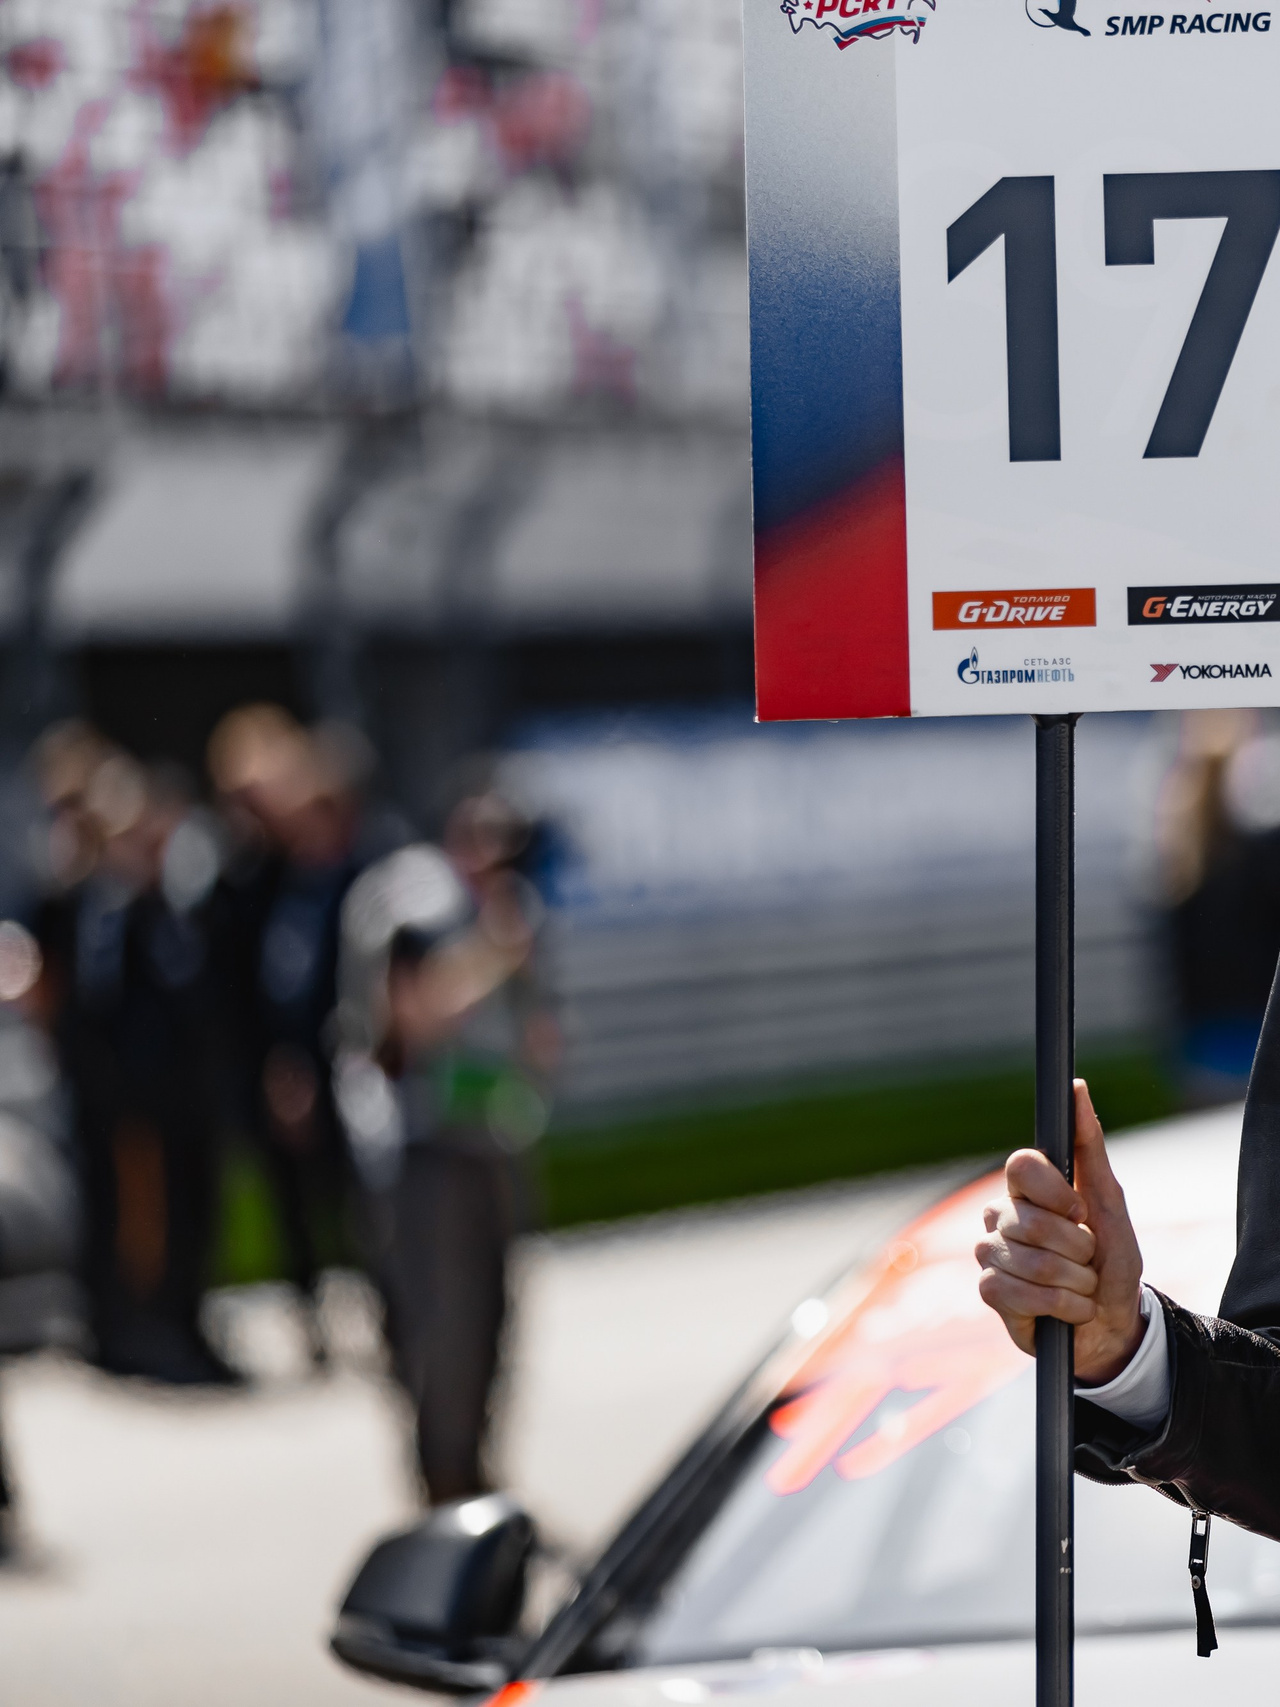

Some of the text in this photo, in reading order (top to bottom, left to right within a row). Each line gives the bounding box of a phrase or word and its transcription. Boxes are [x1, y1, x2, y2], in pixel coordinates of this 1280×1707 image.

[1105, 12, 1271, 36] SMP RACING
[1013, 595, 1071, 604] ТОПЛИВО
[1023, 657, 1071, 667] СЕТЬ АЗС
[1179, 663, 1272, 680] YOKOHAMA
